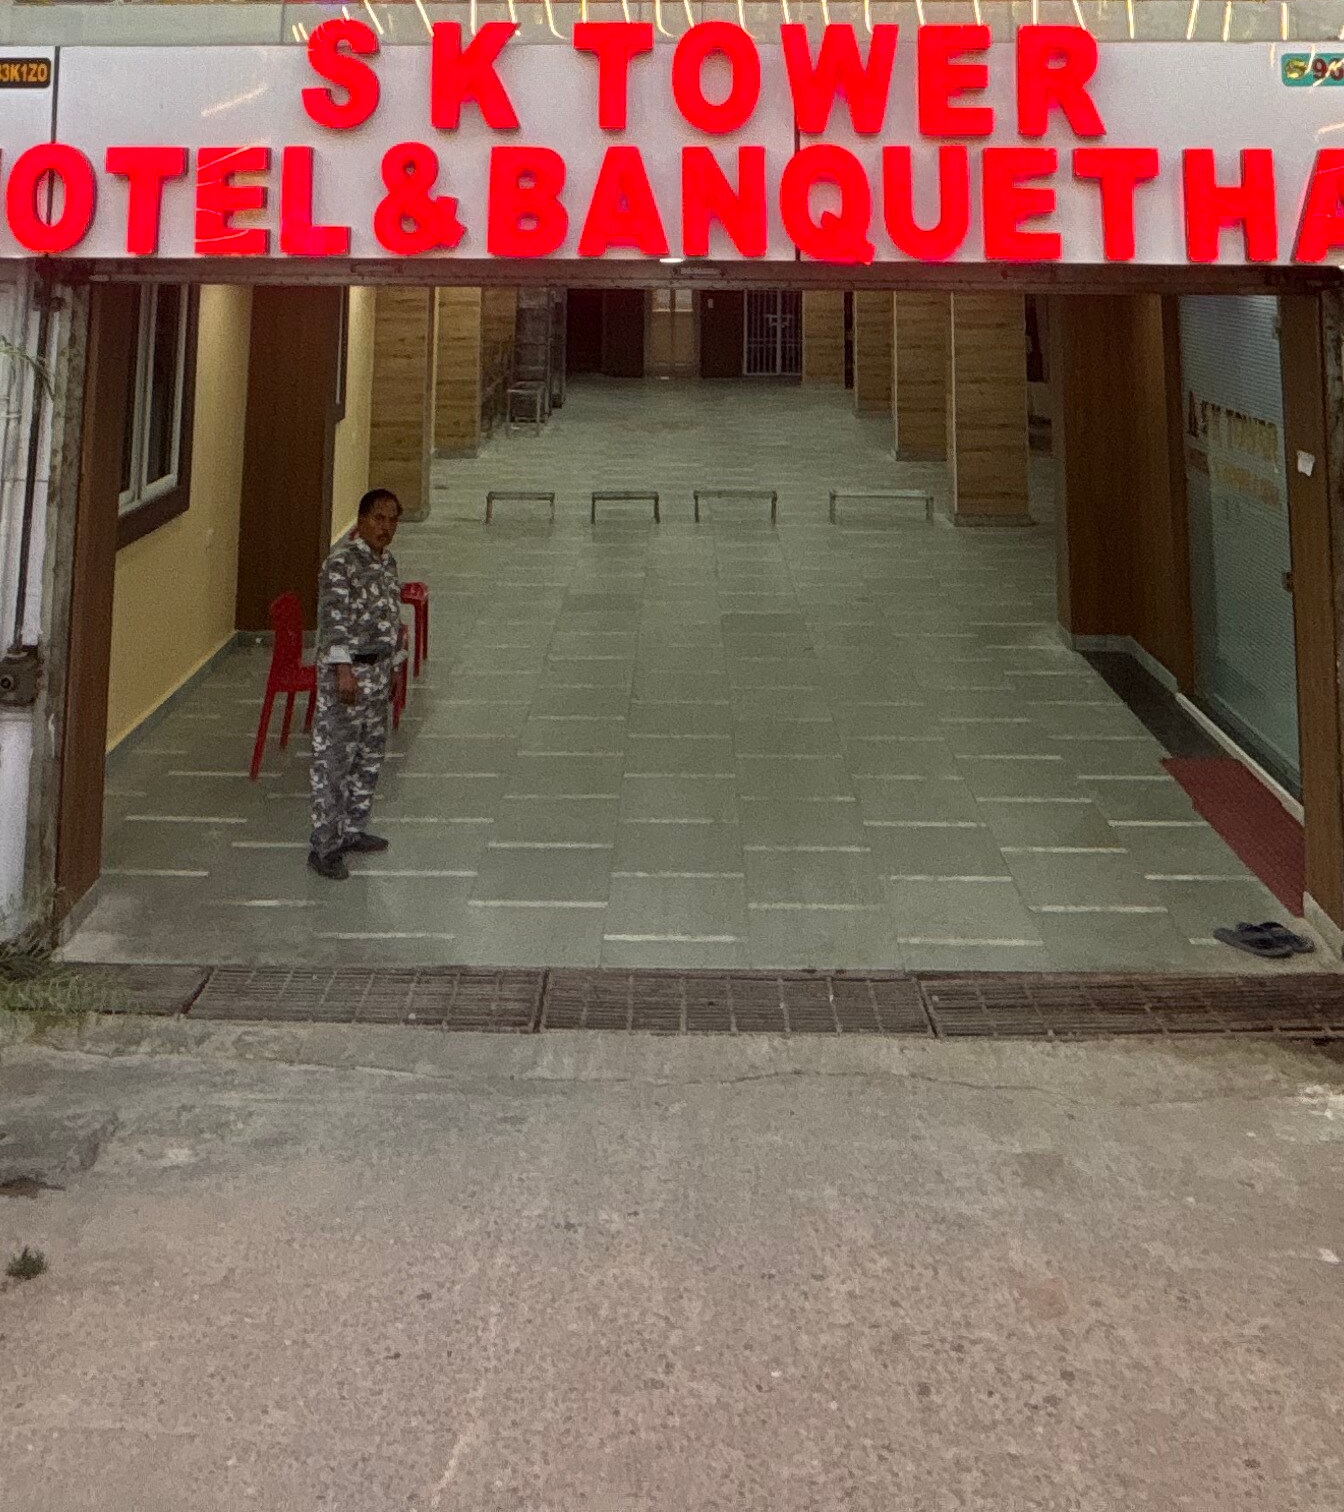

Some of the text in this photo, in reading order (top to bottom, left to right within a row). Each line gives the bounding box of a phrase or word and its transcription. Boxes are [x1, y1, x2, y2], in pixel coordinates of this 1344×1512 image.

[301, 19, 1107, 137] S K TOWER
[373, 142, 465, 257] &
[487, 144, 1159, 265] BANQUET
